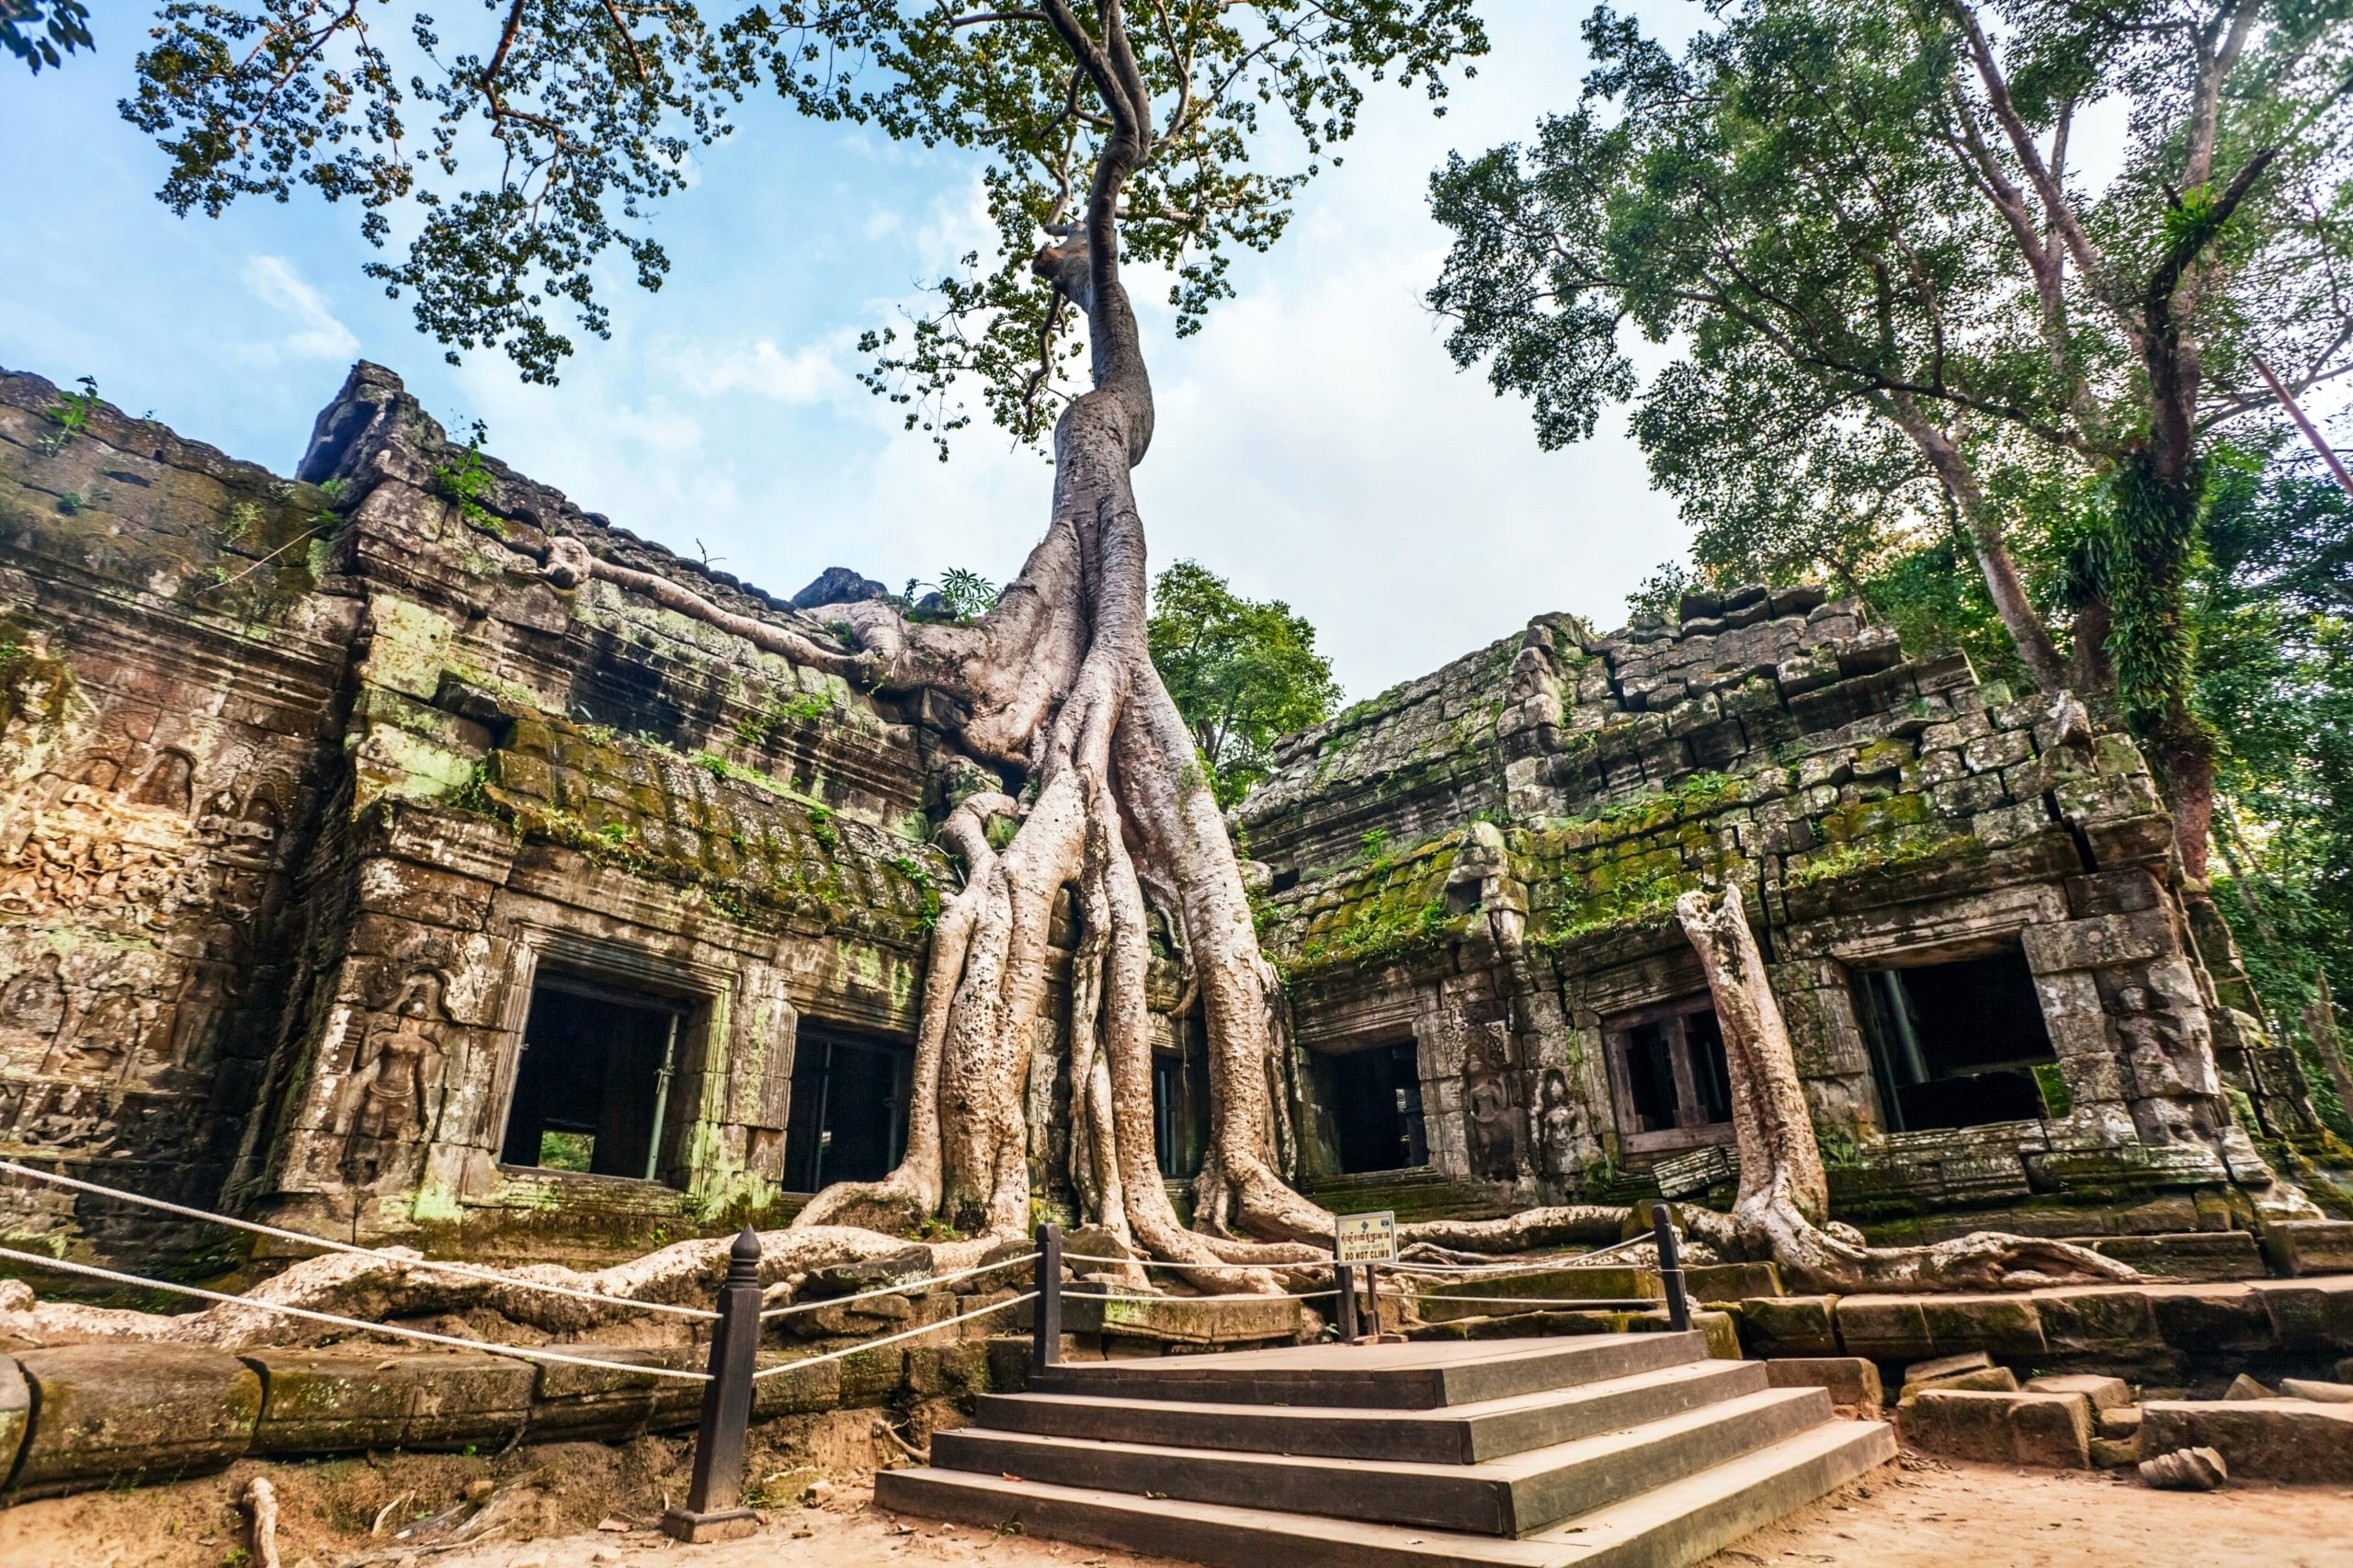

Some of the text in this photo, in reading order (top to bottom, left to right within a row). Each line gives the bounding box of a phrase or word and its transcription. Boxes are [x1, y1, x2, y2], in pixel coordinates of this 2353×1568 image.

[1346, 1250, 1389, 1260] DO NOT CLIMB
